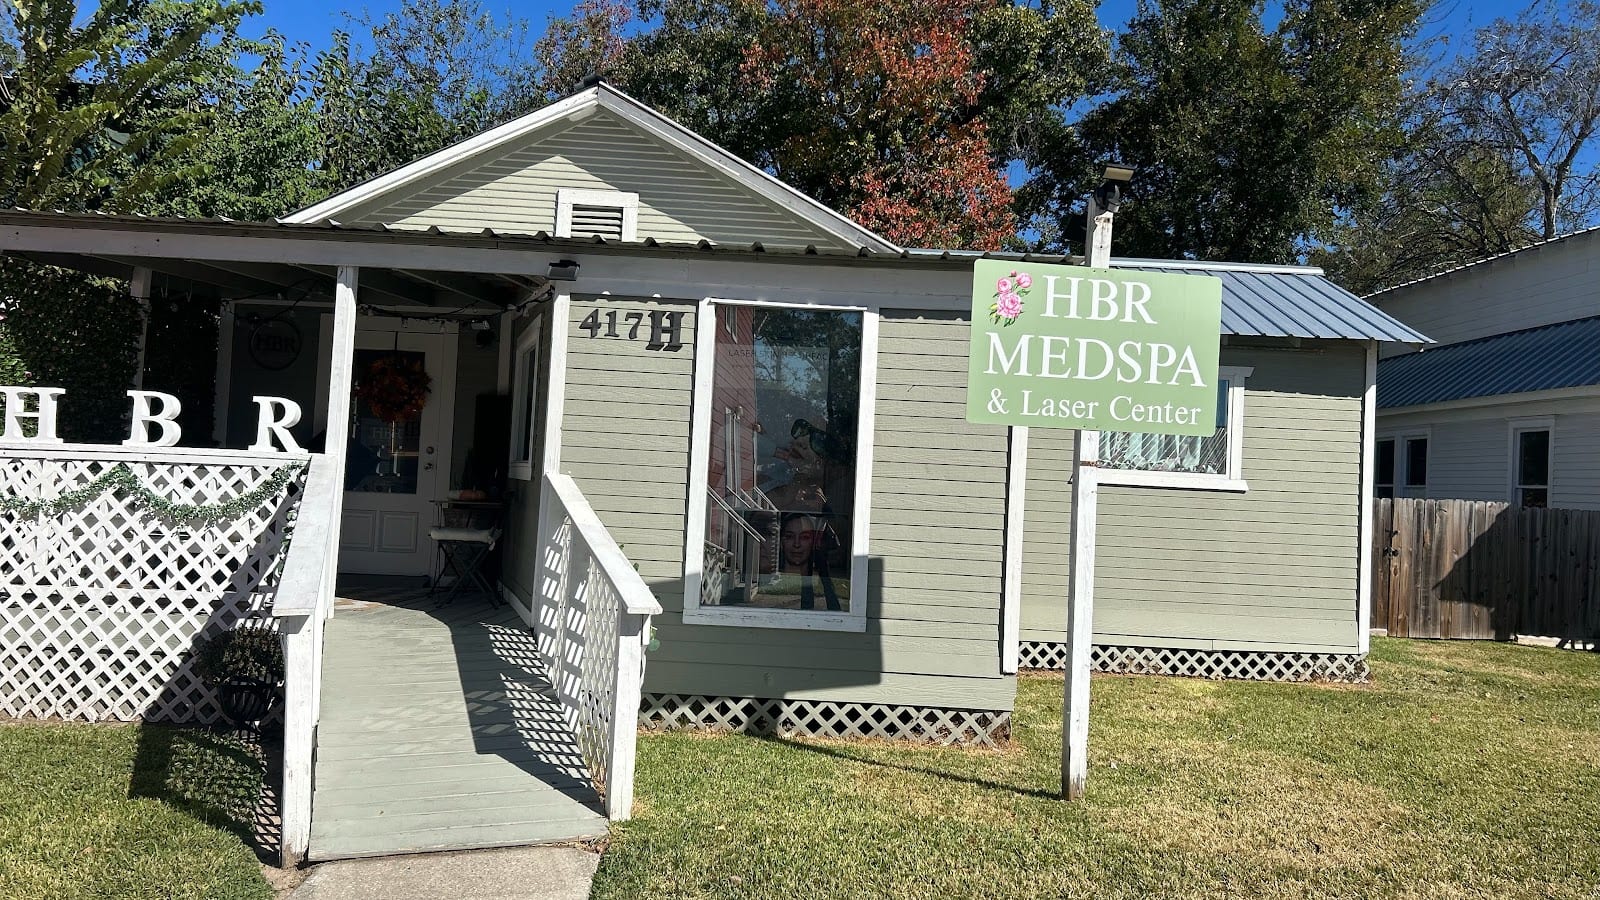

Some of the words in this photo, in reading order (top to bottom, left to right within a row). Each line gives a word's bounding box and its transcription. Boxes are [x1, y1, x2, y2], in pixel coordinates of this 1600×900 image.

[1039, 274, 1158, 325] HBR
[256, 334, 296, 352] HBR
[983, 331, 1208, 388] MEDSPA
[987, 388, 1010, 415] &
[1019, 390, 1099, 420] Laser
[1109, 395, 1203, 425] Center
